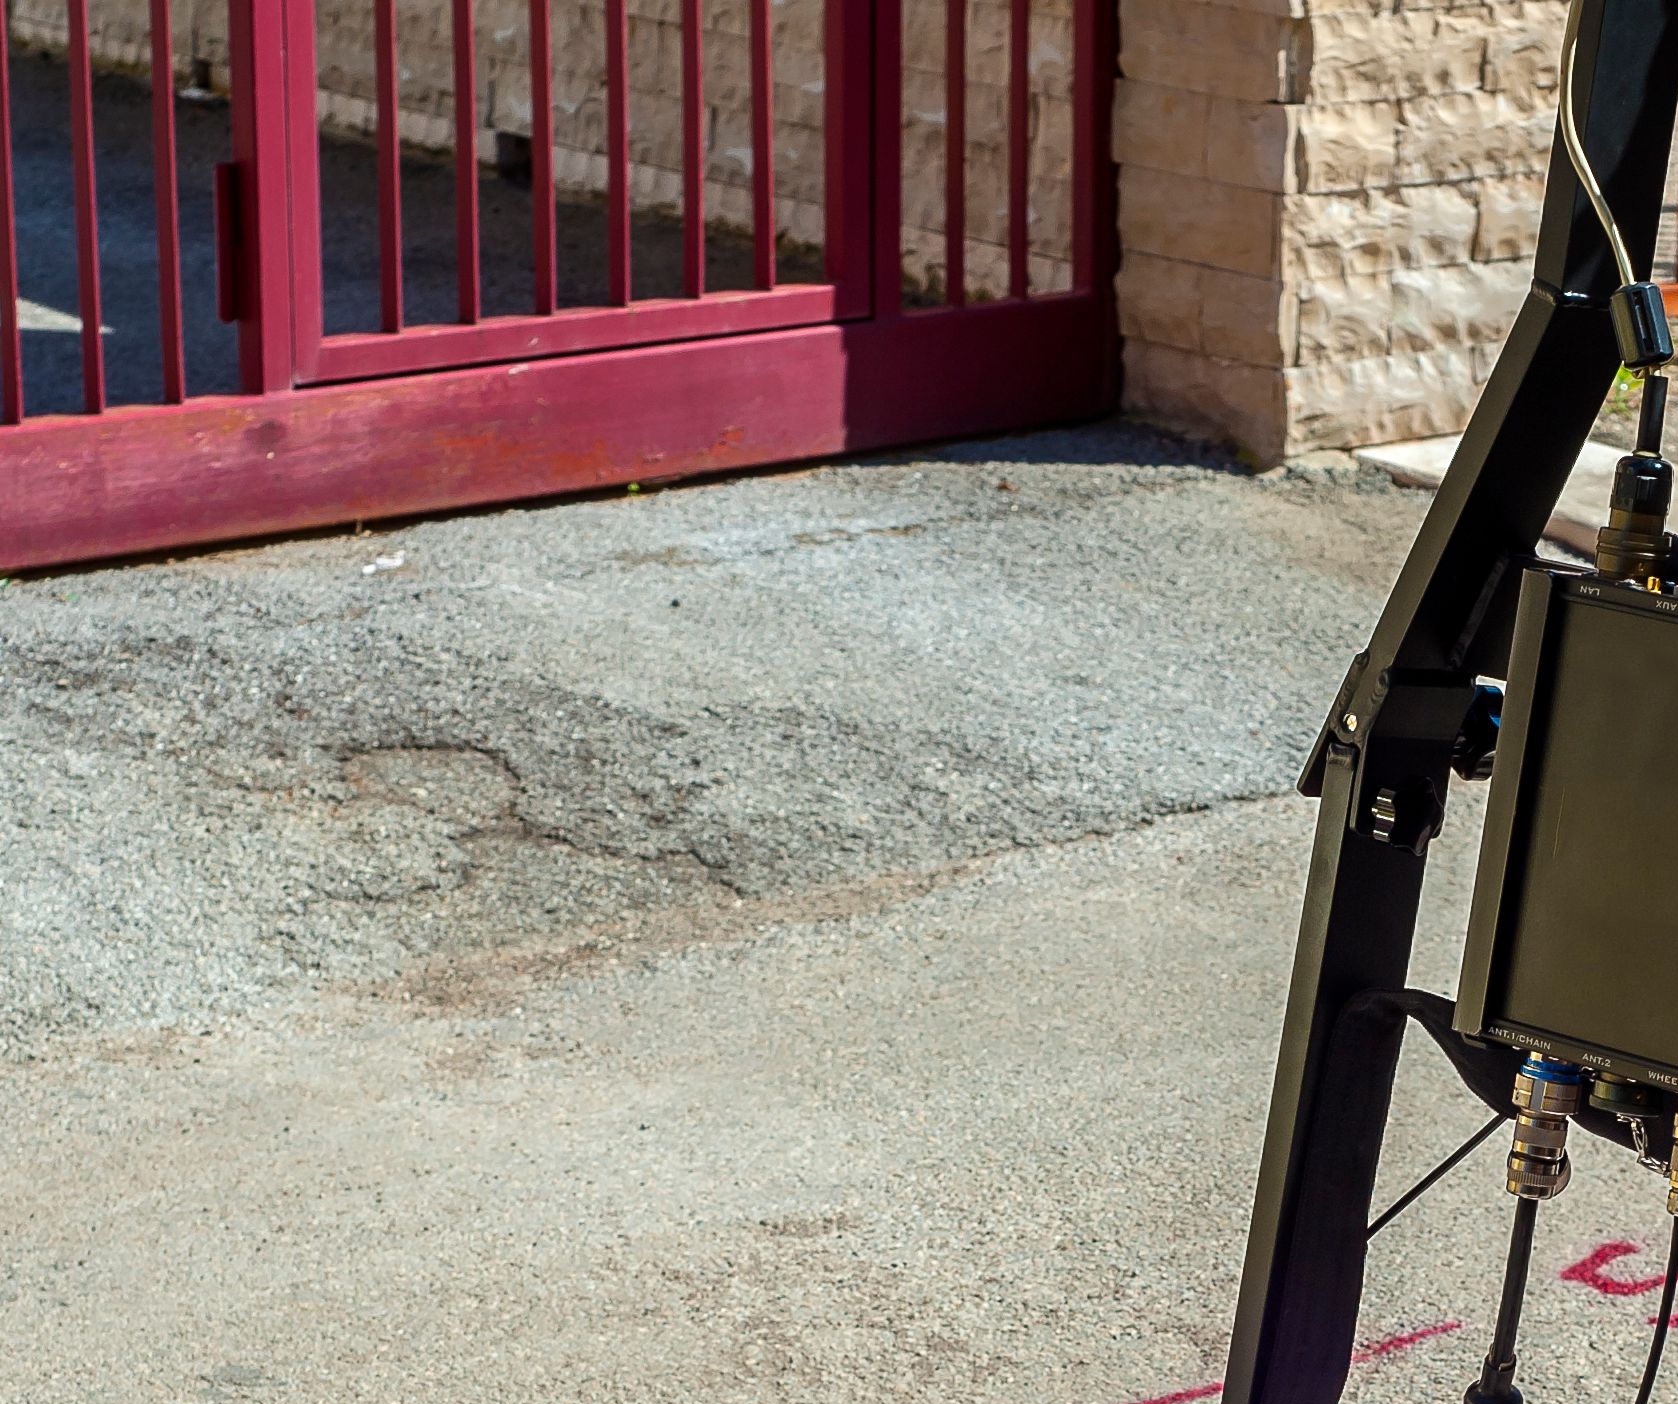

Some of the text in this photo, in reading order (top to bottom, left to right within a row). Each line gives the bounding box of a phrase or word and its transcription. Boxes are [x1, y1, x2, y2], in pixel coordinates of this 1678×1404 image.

[1579, 585, 1600, 596] LAN
[1655, 600, 1678, 611] AUX
[1488, 1026, 1551, 1050] ANT.1/CHAIN
[1582, 1053, 1611, 1067] ANT.2
